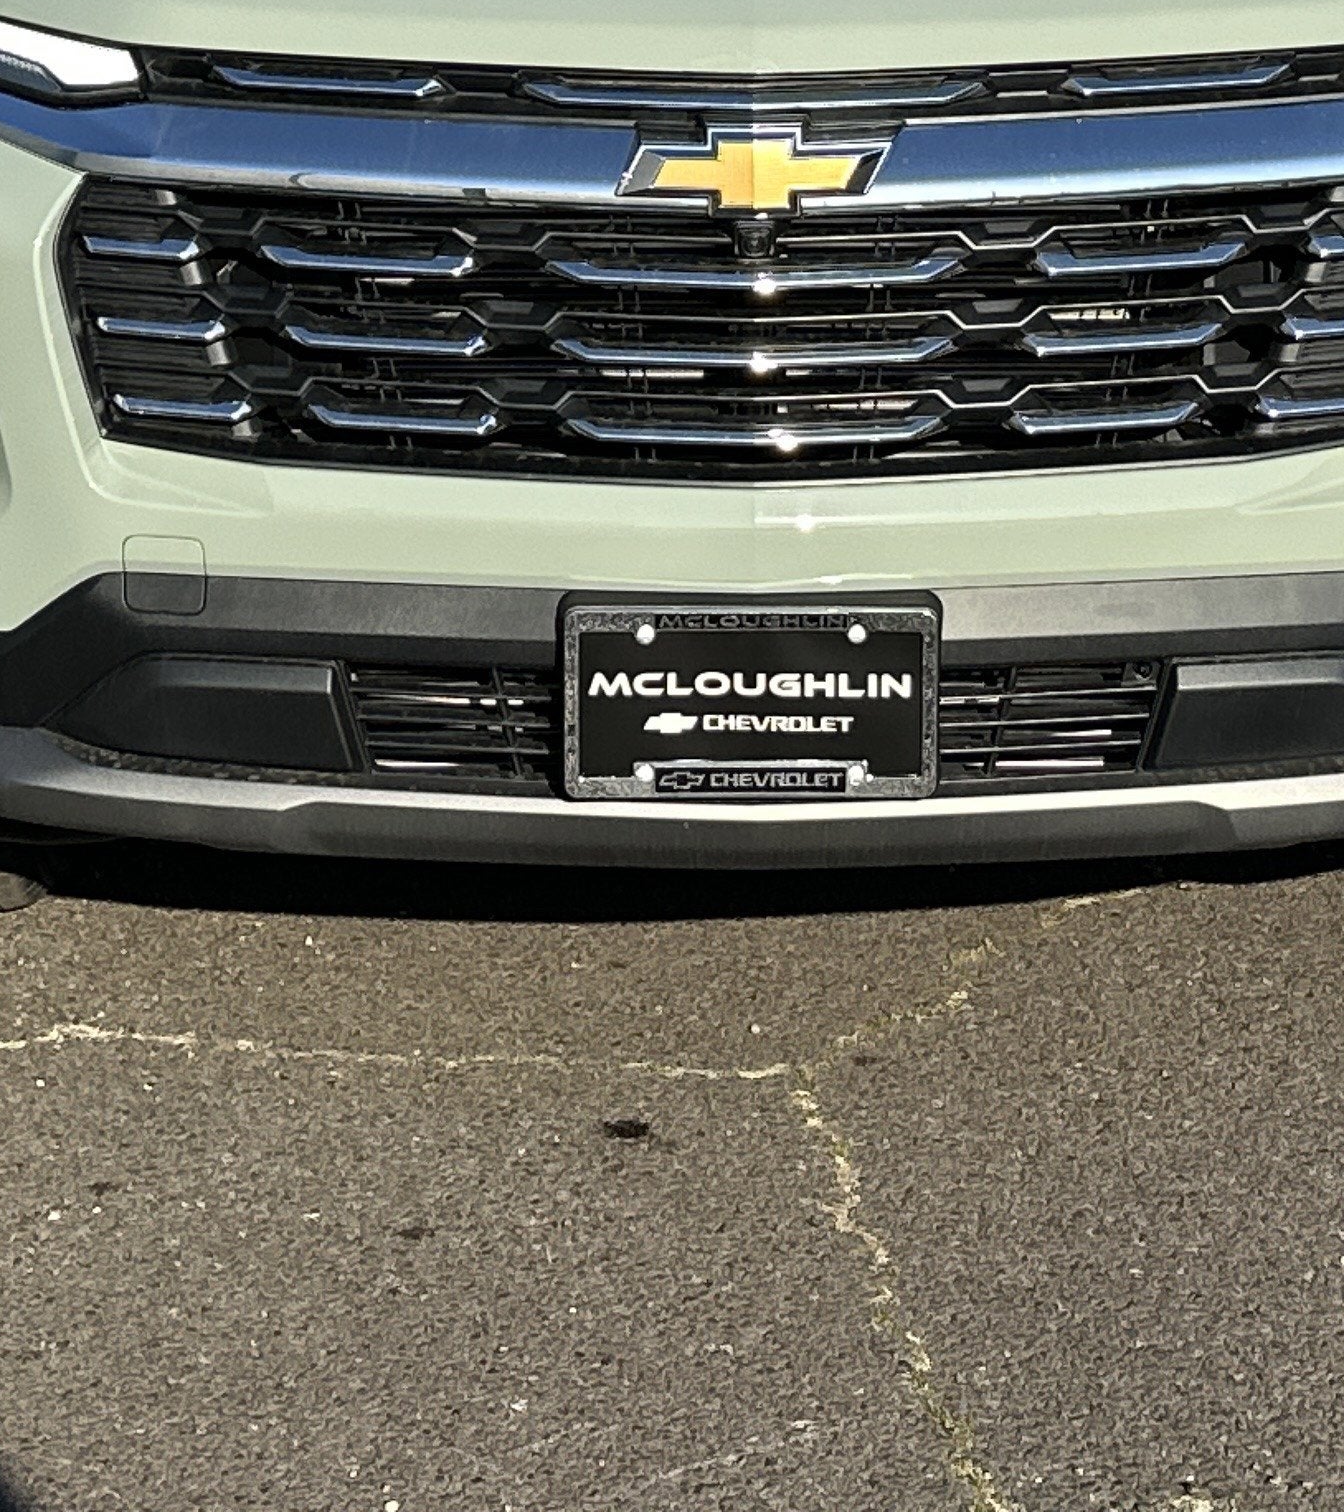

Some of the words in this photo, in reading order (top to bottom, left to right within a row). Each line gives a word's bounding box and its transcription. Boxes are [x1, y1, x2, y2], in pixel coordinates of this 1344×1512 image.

[658, 614, 846, 629] MCLOUGHLIN
[588, 671, 912, 699] MCLOUGHLIN
[702, 715, 855, 733] CHEVROLET
[709, 772, 844, 789] CHEVROLET
